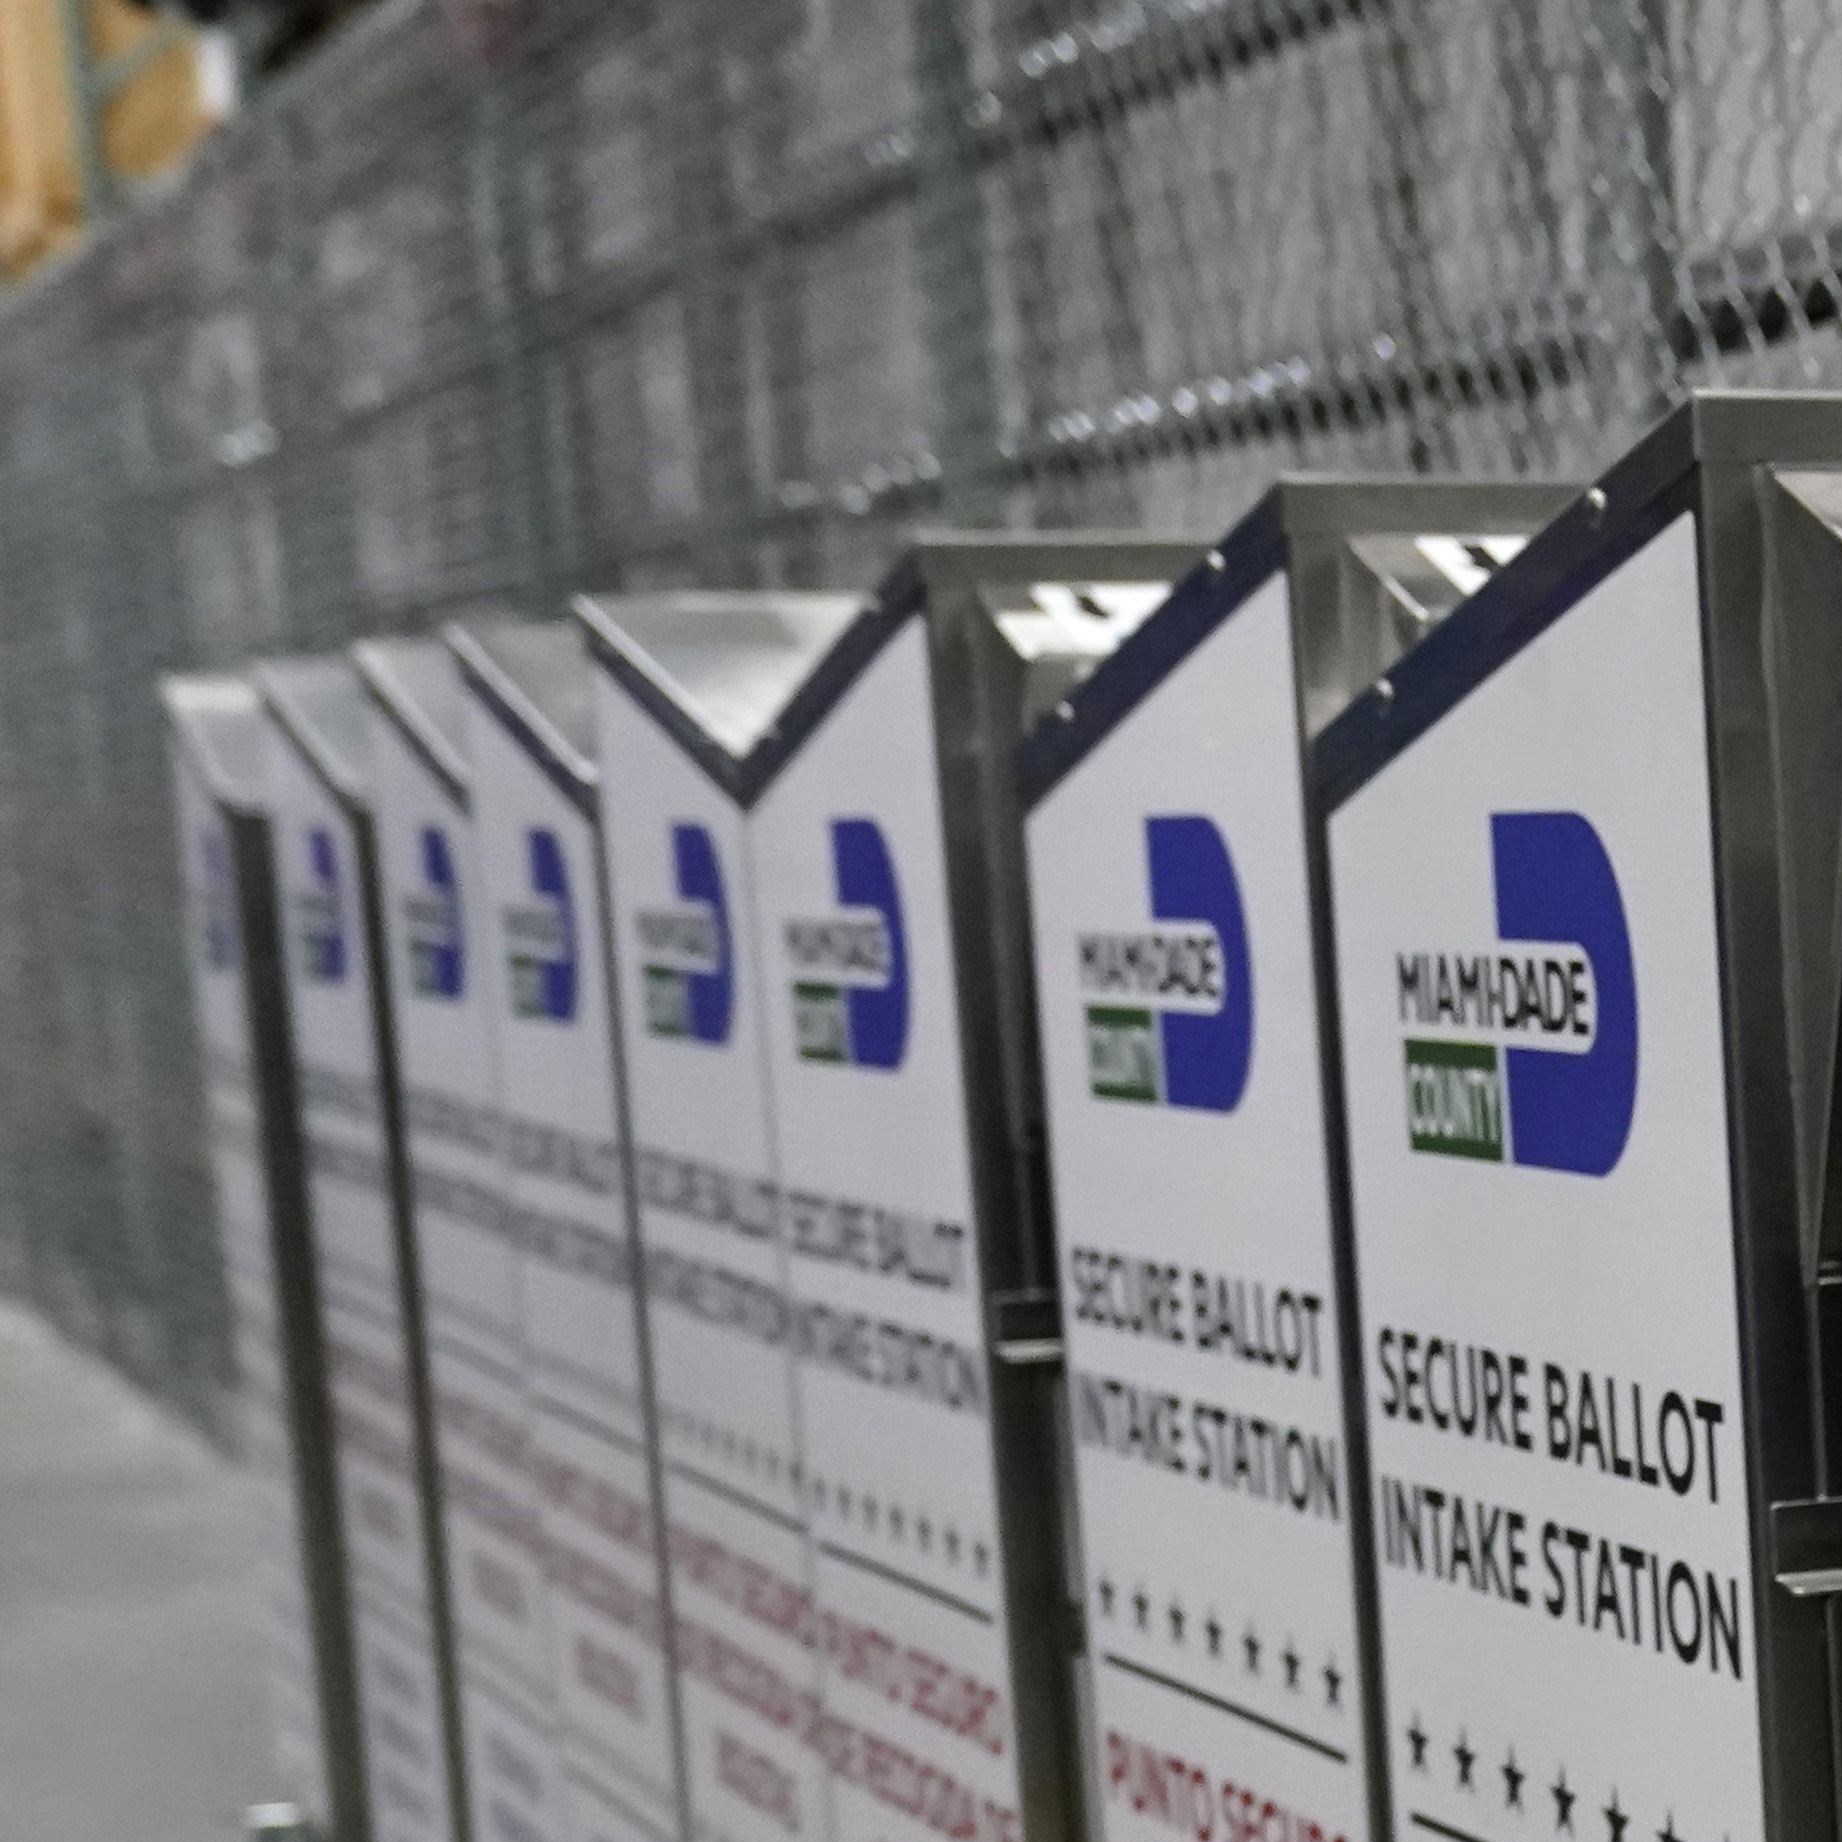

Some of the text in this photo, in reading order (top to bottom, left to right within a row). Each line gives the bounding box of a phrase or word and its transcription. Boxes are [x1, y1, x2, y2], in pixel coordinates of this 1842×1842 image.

[1397, 952, 1589, 1034] MIAMI-DADE
[1380, 1327, 1723, 1503] SECURE BALLOT
[1382, 1474, 1742, 1681] INTAKE STATION
